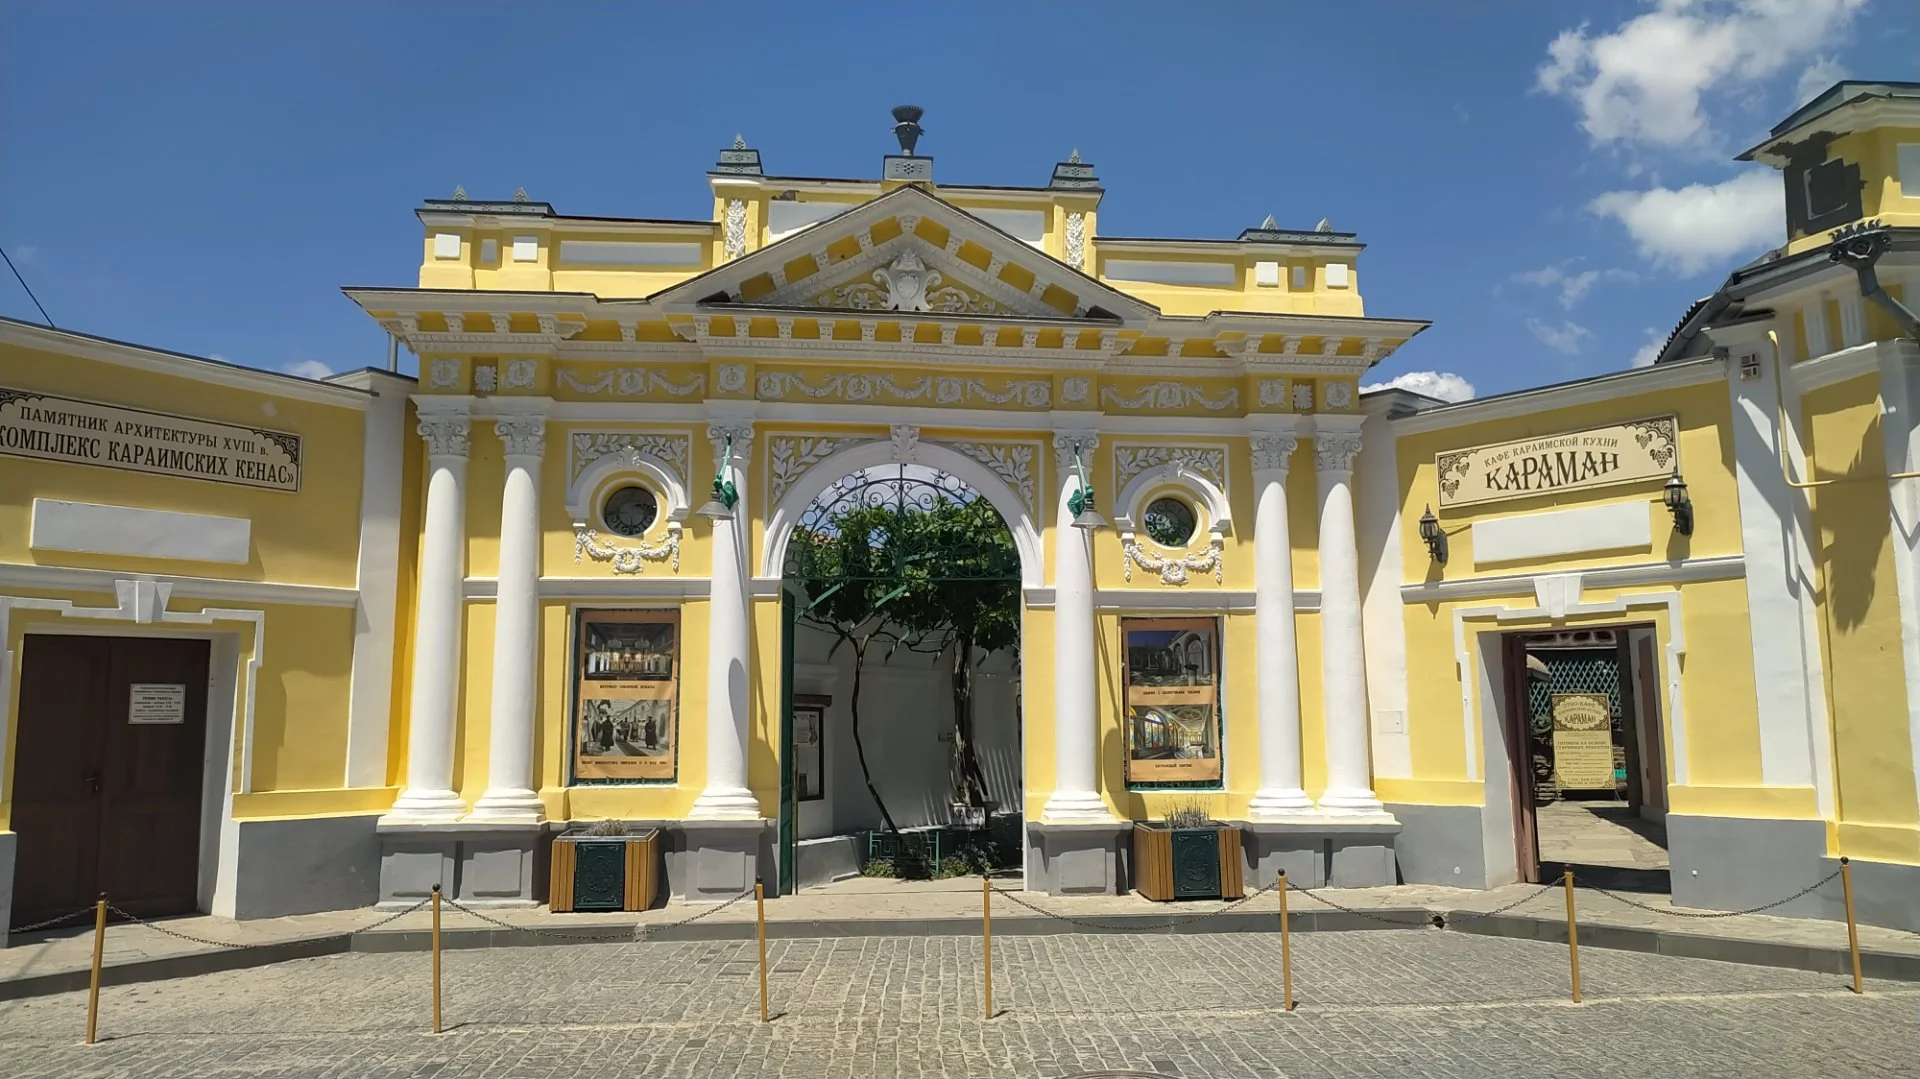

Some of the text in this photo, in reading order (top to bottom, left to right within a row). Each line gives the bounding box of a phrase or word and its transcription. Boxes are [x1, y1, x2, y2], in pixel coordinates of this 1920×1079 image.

[20, 406, 109, 432] ПАМЯТНИК
[114, 420, 218, 448] АРХИТЕКТУРЫ
[107, 440, 229, 476] КАРАИМСКИХ
[235, 459, 294, 484] КЕНАС»
[1484, 436, 1618, 468] КАФЕ КАРАИМСКОЙ КУХНИ
[1484, 451, 1620, 491] КАРАМАН
